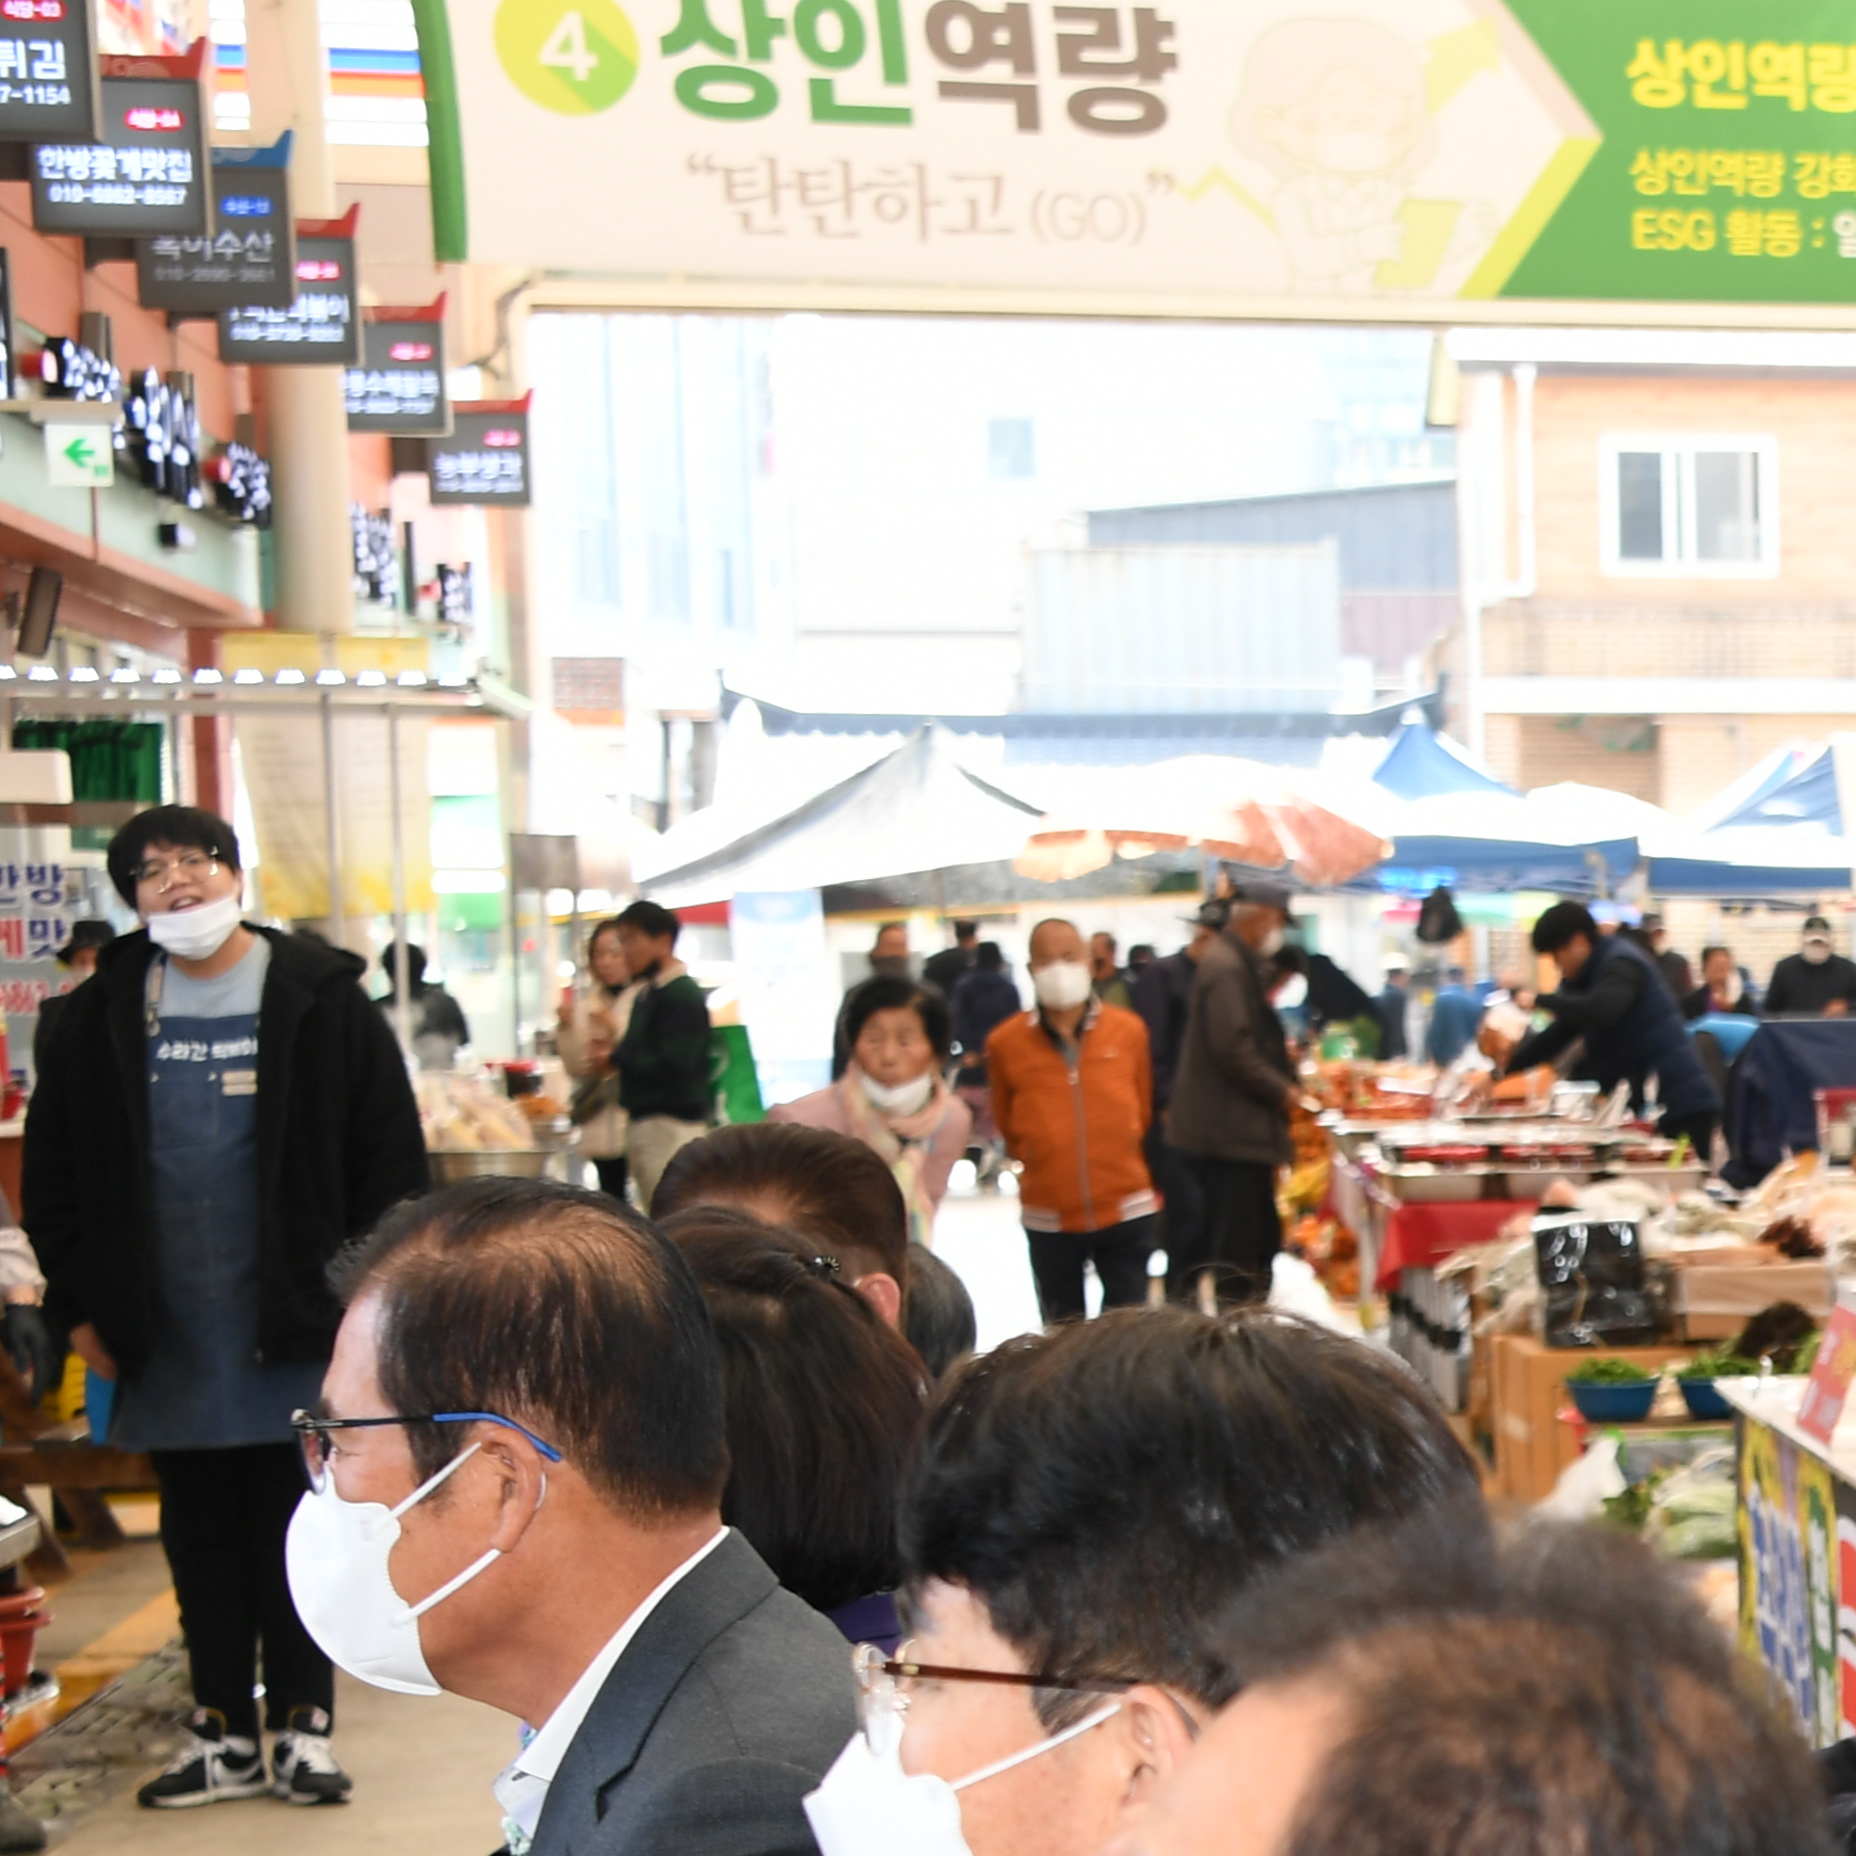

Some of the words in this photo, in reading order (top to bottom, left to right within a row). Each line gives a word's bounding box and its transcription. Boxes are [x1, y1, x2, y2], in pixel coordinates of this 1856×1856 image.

[537, 9, 600, 81] 4
[659, 0, 1181, 137] 상인역량
[1630, 149, 1786, 199] 상인역량
[1632, 209, 1716, 251] ESG
[1724, 208, 1802, 257] 활동
